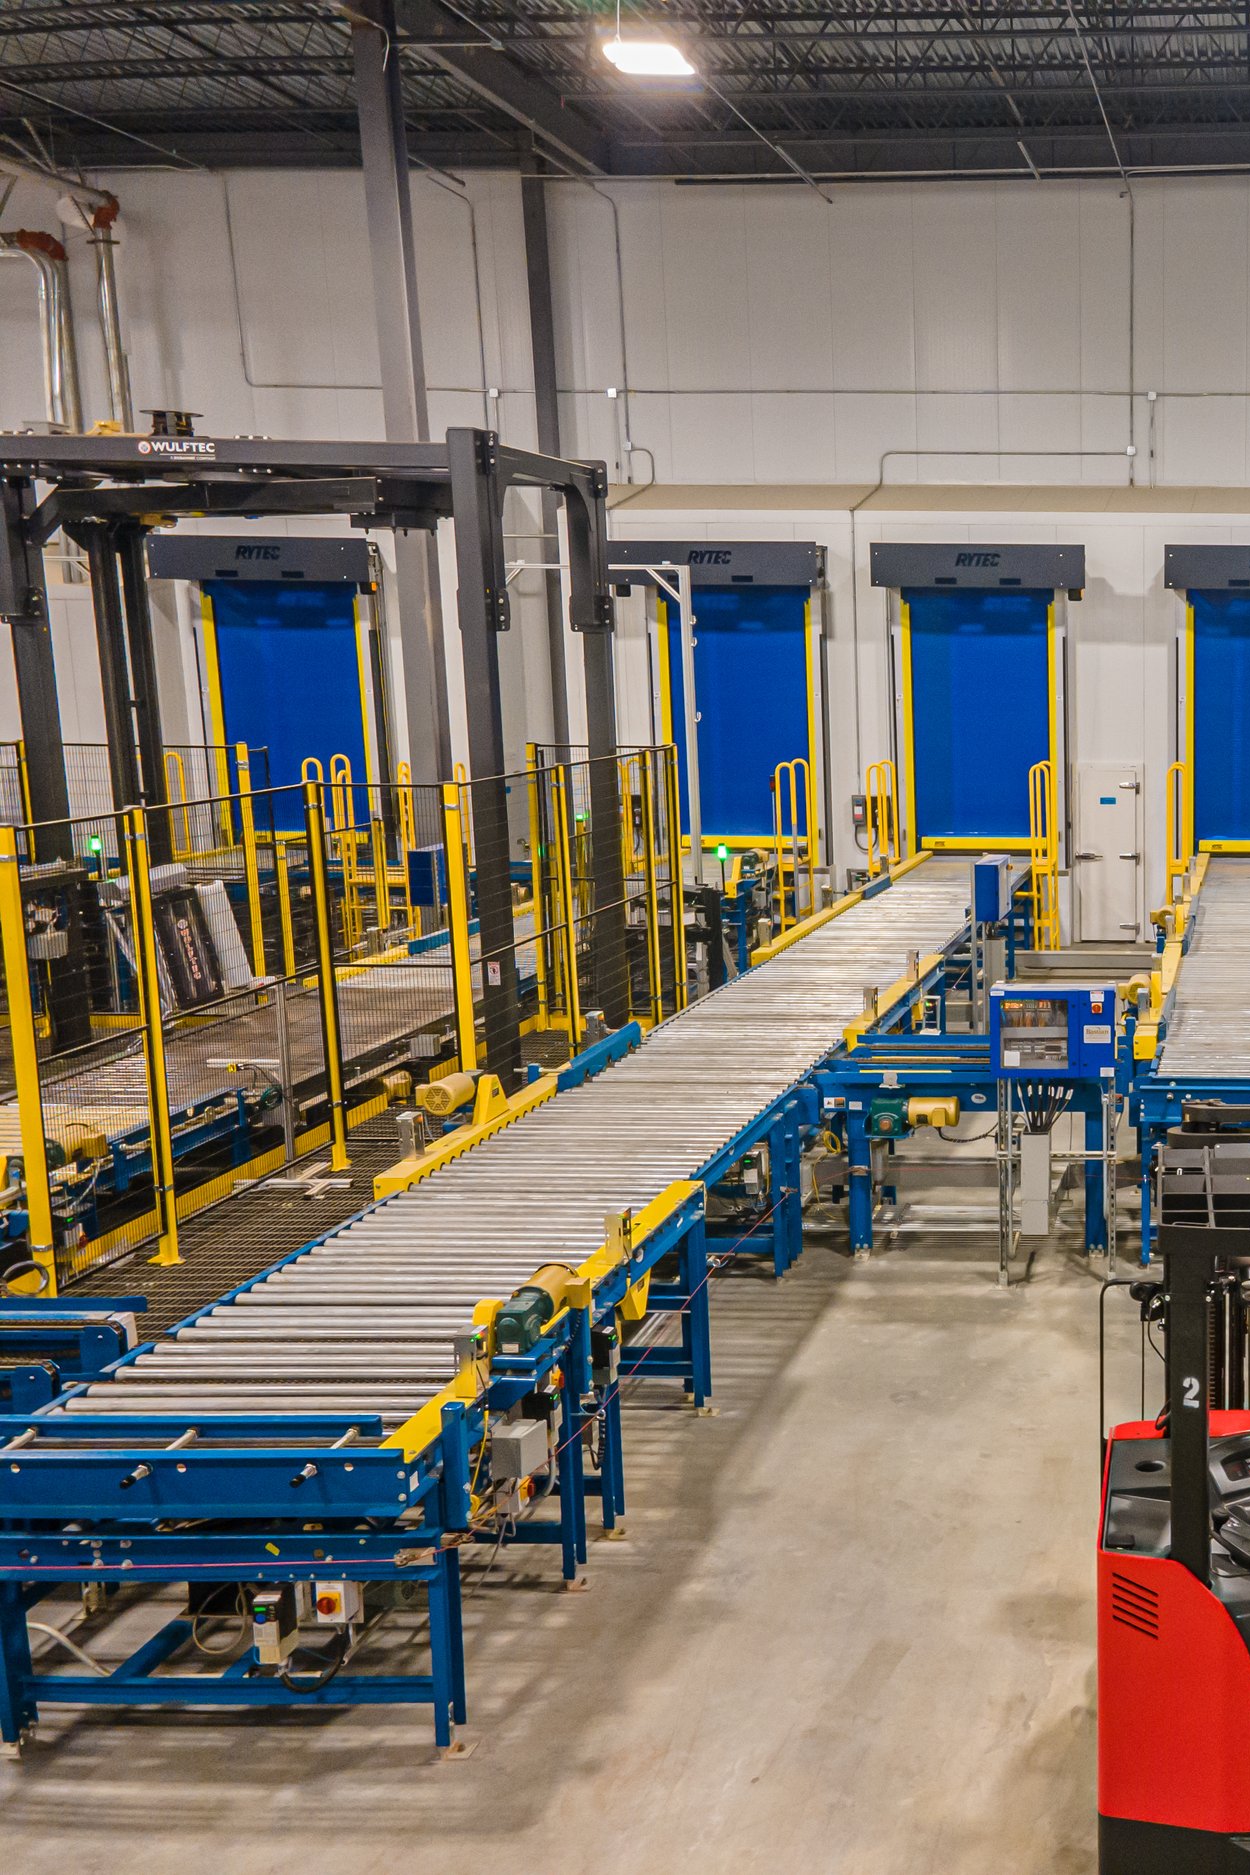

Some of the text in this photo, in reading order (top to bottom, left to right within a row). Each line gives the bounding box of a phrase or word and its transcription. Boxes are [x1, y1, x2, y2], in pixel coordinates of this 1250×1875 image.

[151, 442, 216, 453] WULFTEC
[235, 545, 281, 560] RYTEC
[688, 550, 732, 565] RYTEC
[955, 552, 1002, 567] RYTEC
[1182, 1376, 1200, 1409] 2
